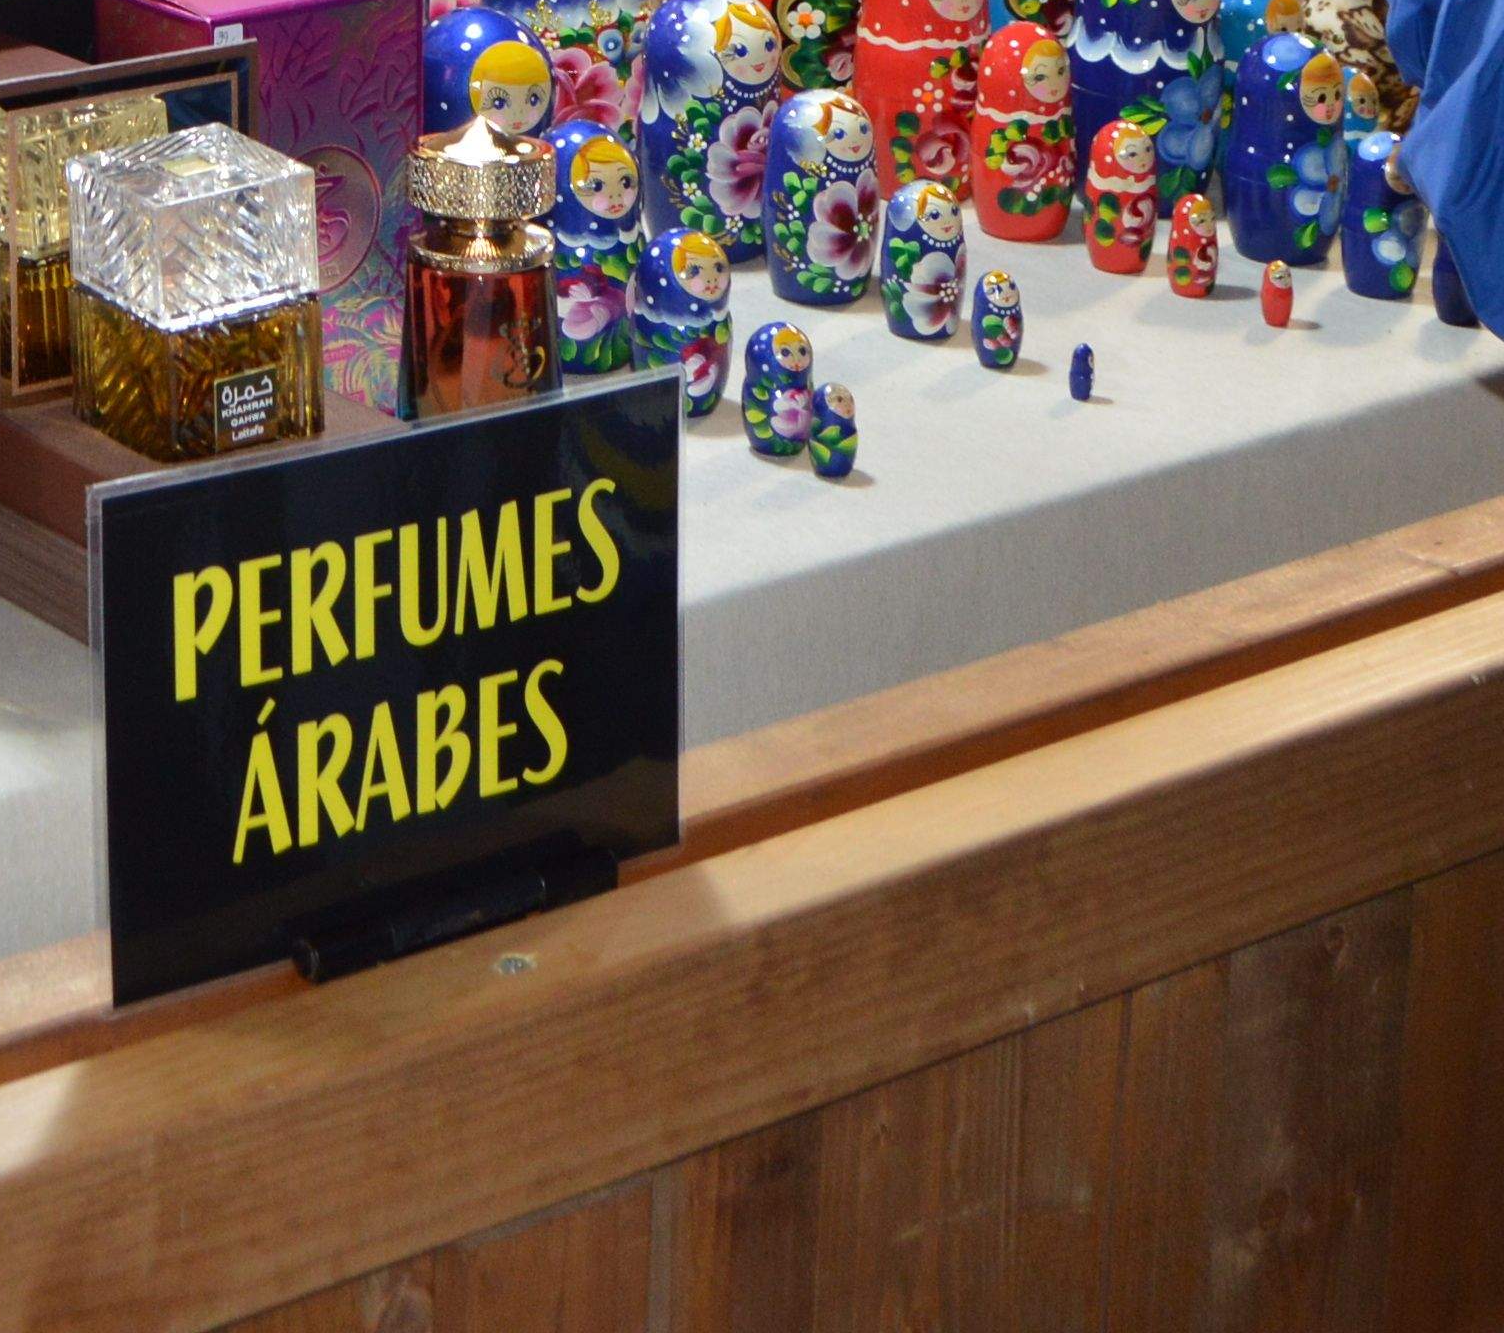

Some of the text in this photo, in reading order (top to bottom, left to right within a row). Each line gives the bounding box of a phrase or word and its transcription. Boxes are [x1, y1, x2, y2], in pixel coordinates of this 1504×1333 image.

[221, 375, 273, 410] خمرة
[221, 396, 273, 419] KHAMRAH
[172, 477, 621, 702] PERFUMES
[232, 658, 569, 864] ÁRABES
